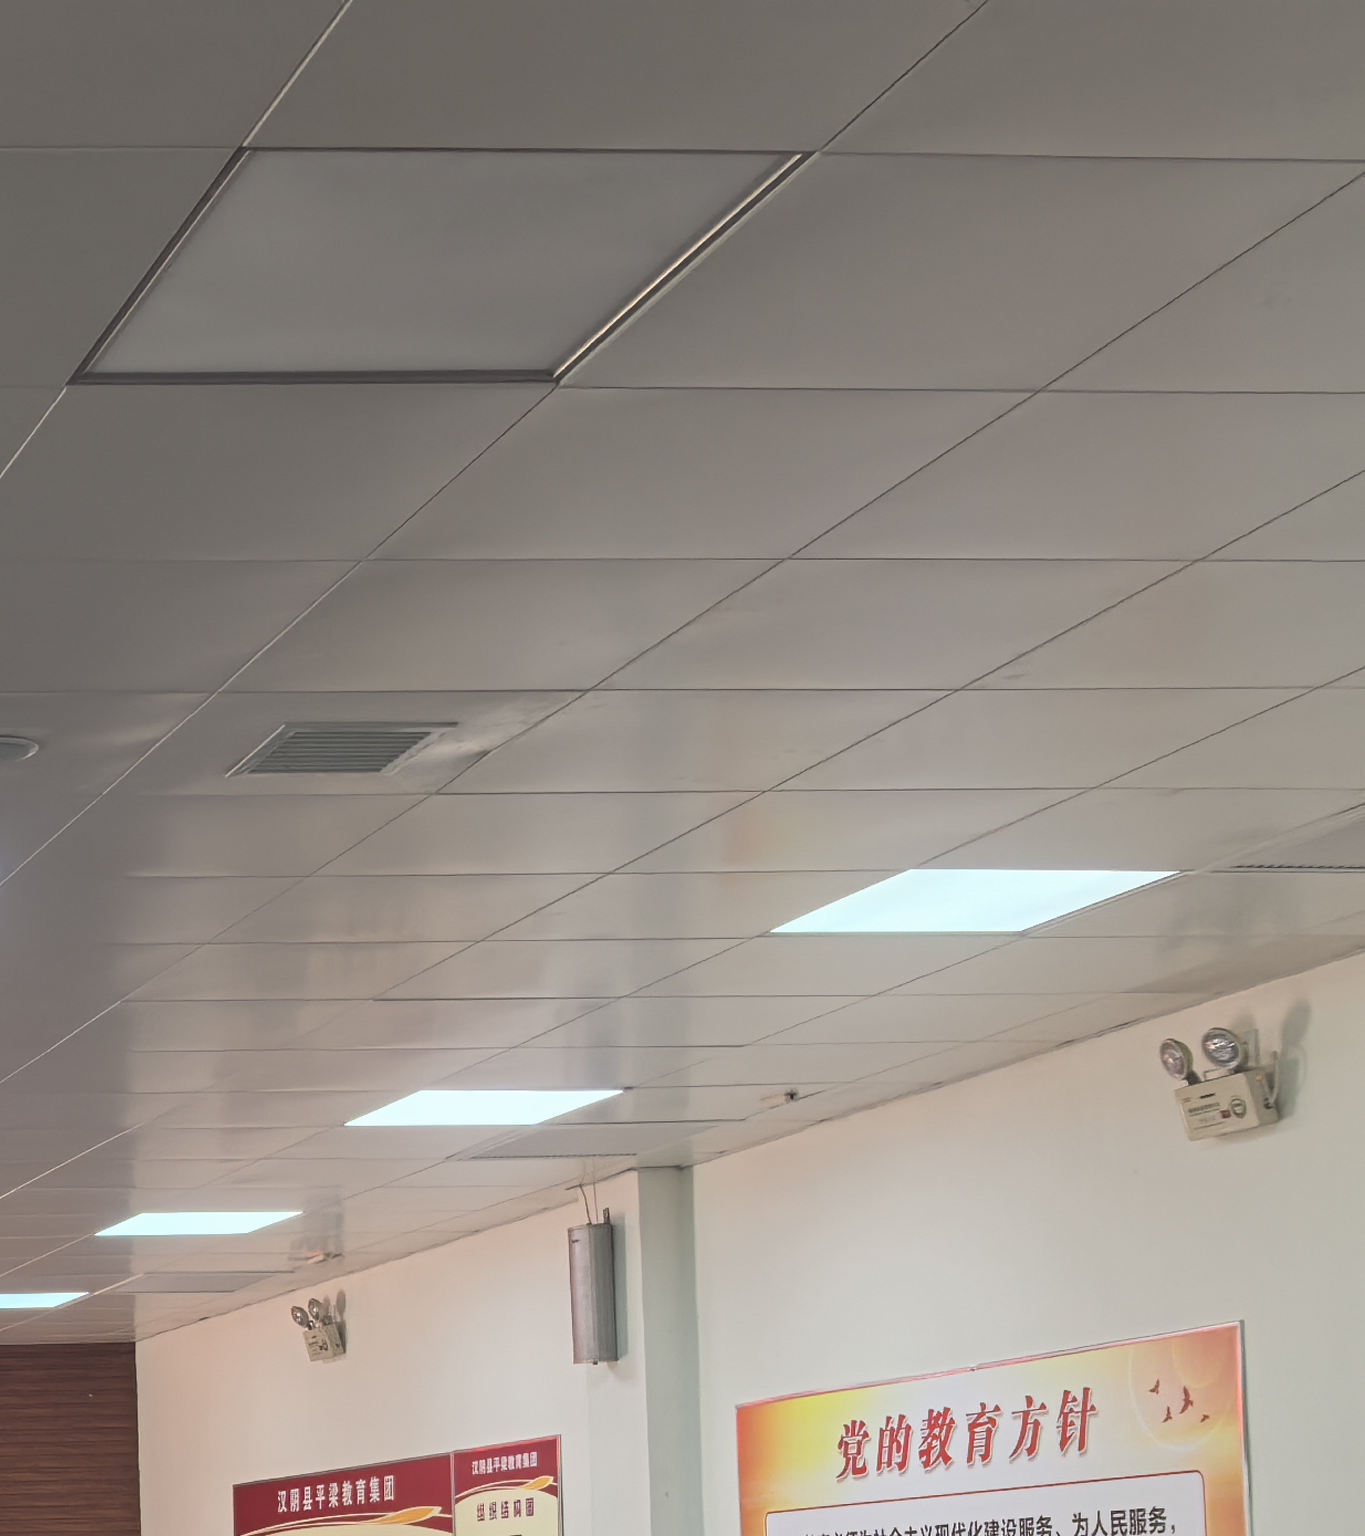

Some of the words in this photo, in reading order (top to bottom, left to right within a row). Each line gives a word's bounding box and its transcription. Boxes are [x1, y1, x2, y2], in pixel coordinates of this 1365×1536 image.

[835, 1386, 1098, 1481] 党的教育方针
[277, 1475, 394, 1513] 汉阴县平梁教育集团
